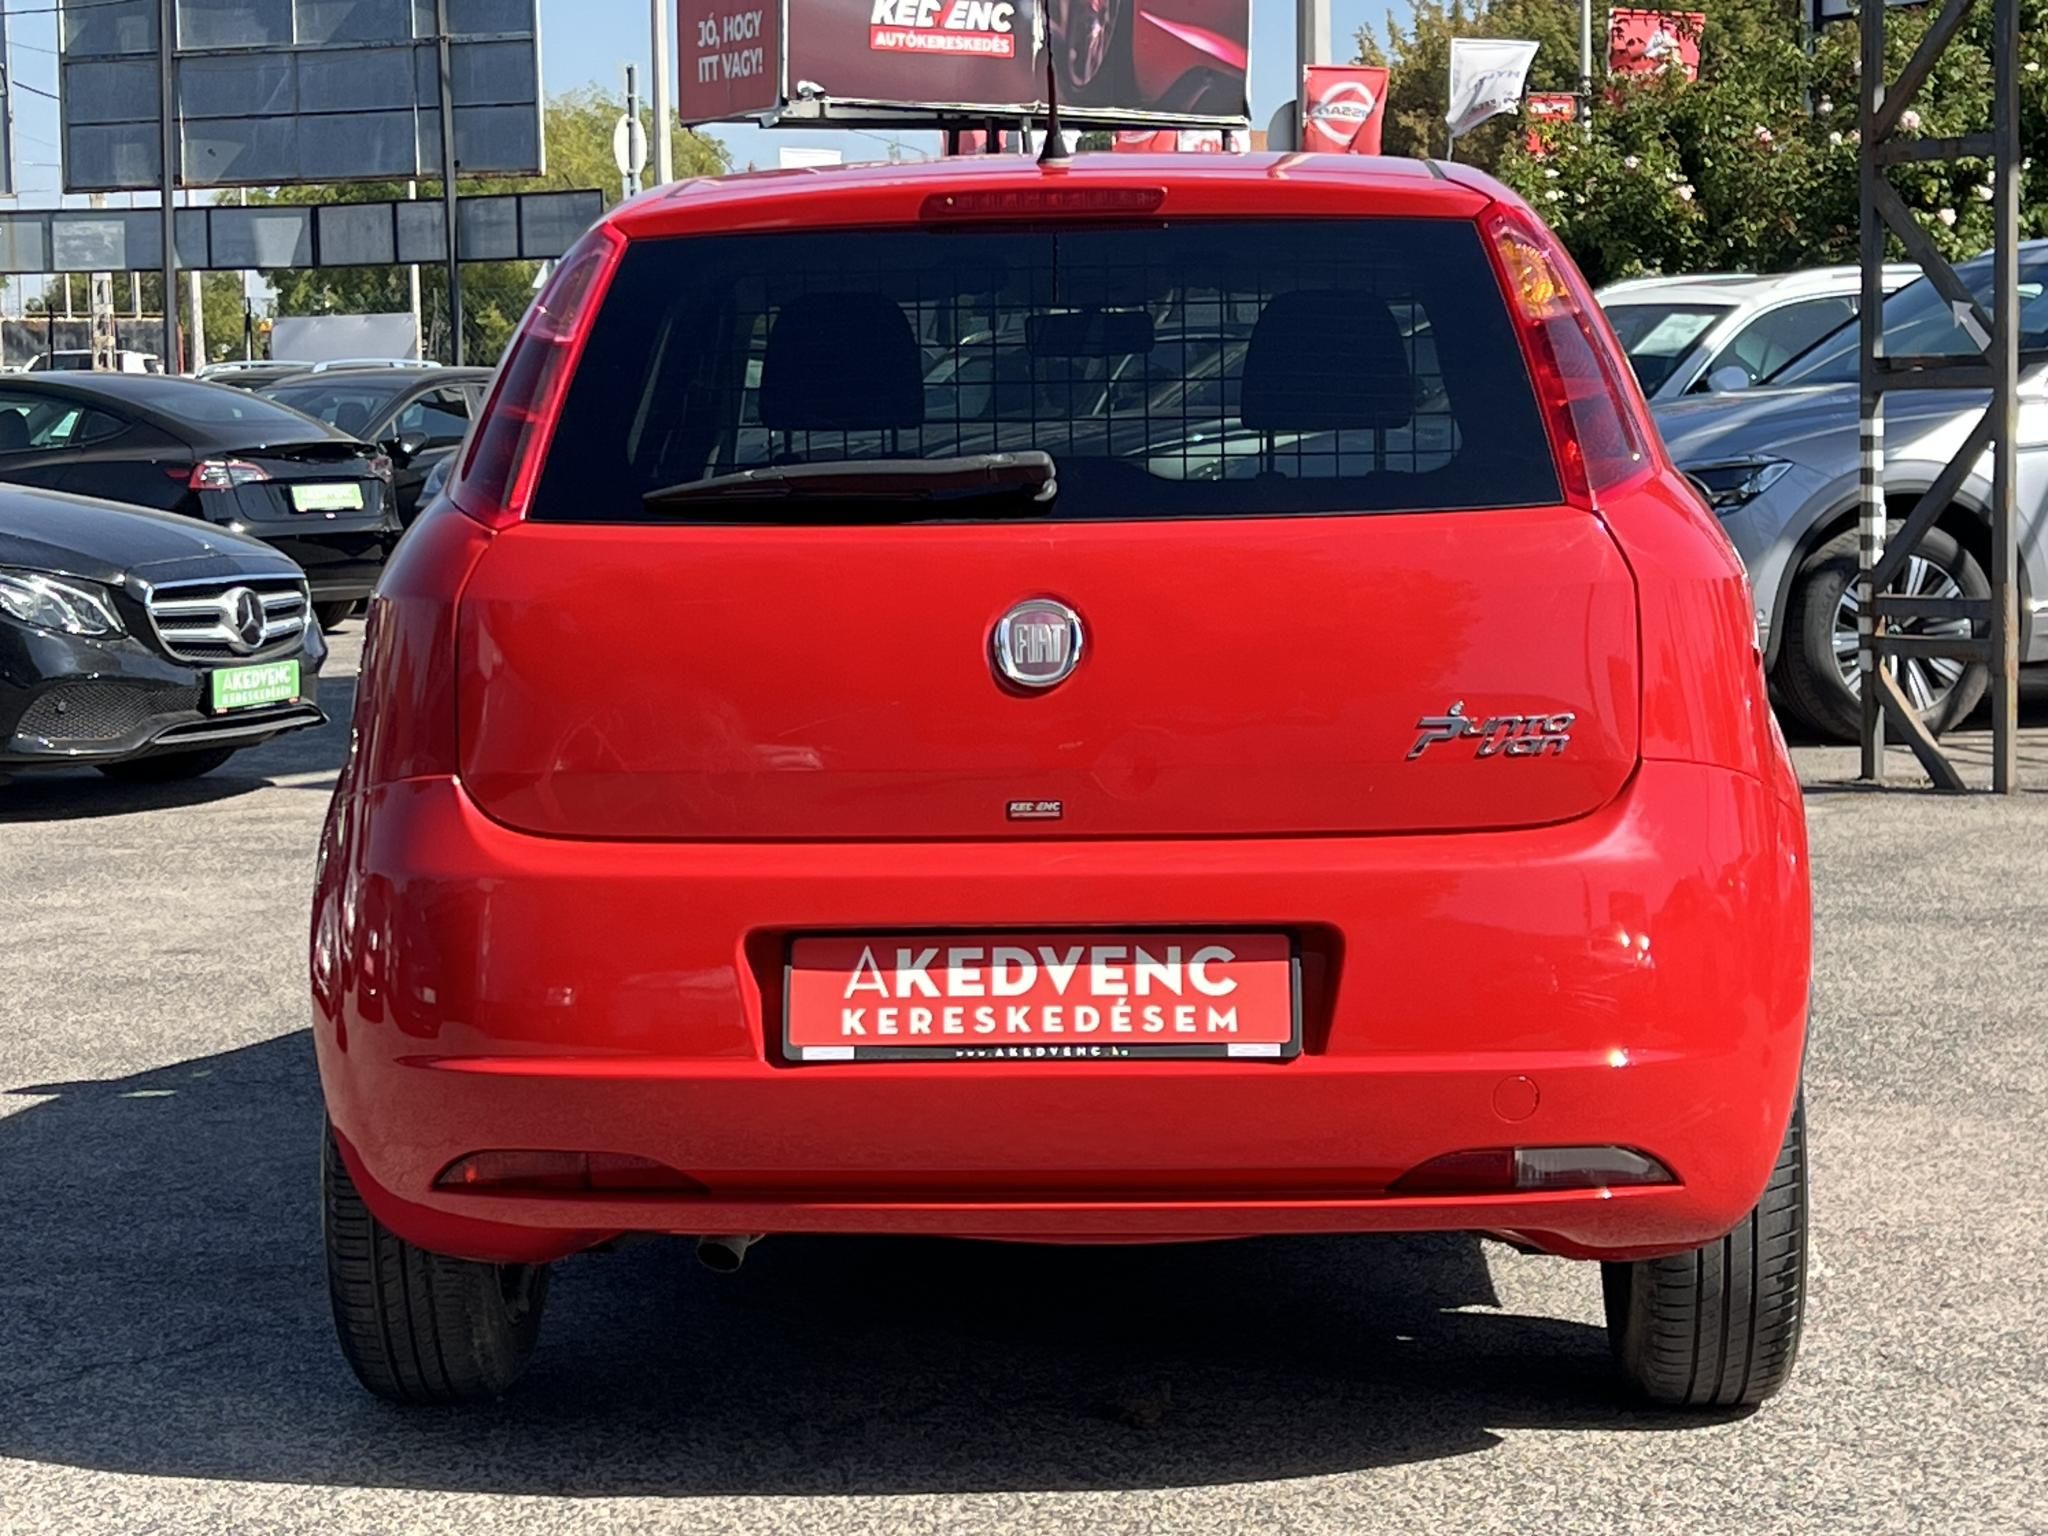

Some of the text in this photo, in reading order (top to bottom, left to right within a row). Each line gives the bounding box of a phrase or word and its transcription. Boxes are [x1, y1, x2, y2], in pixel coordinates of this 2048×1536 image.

[697, 10, 763, 50] JÓ, HOGY
[874, 31, 1010, 53] AUTÓKERESKEDÉS
[698, 47, 763, 83] ITT VAGY!
[1015, 623, 1066, 664] FIAT
[222, 664, 292, 692] AKEDVENC
[844, 944, 1239, 998] AKEDVENC
[841, 998, 1239, 1035] KERESKEDÉSEM
